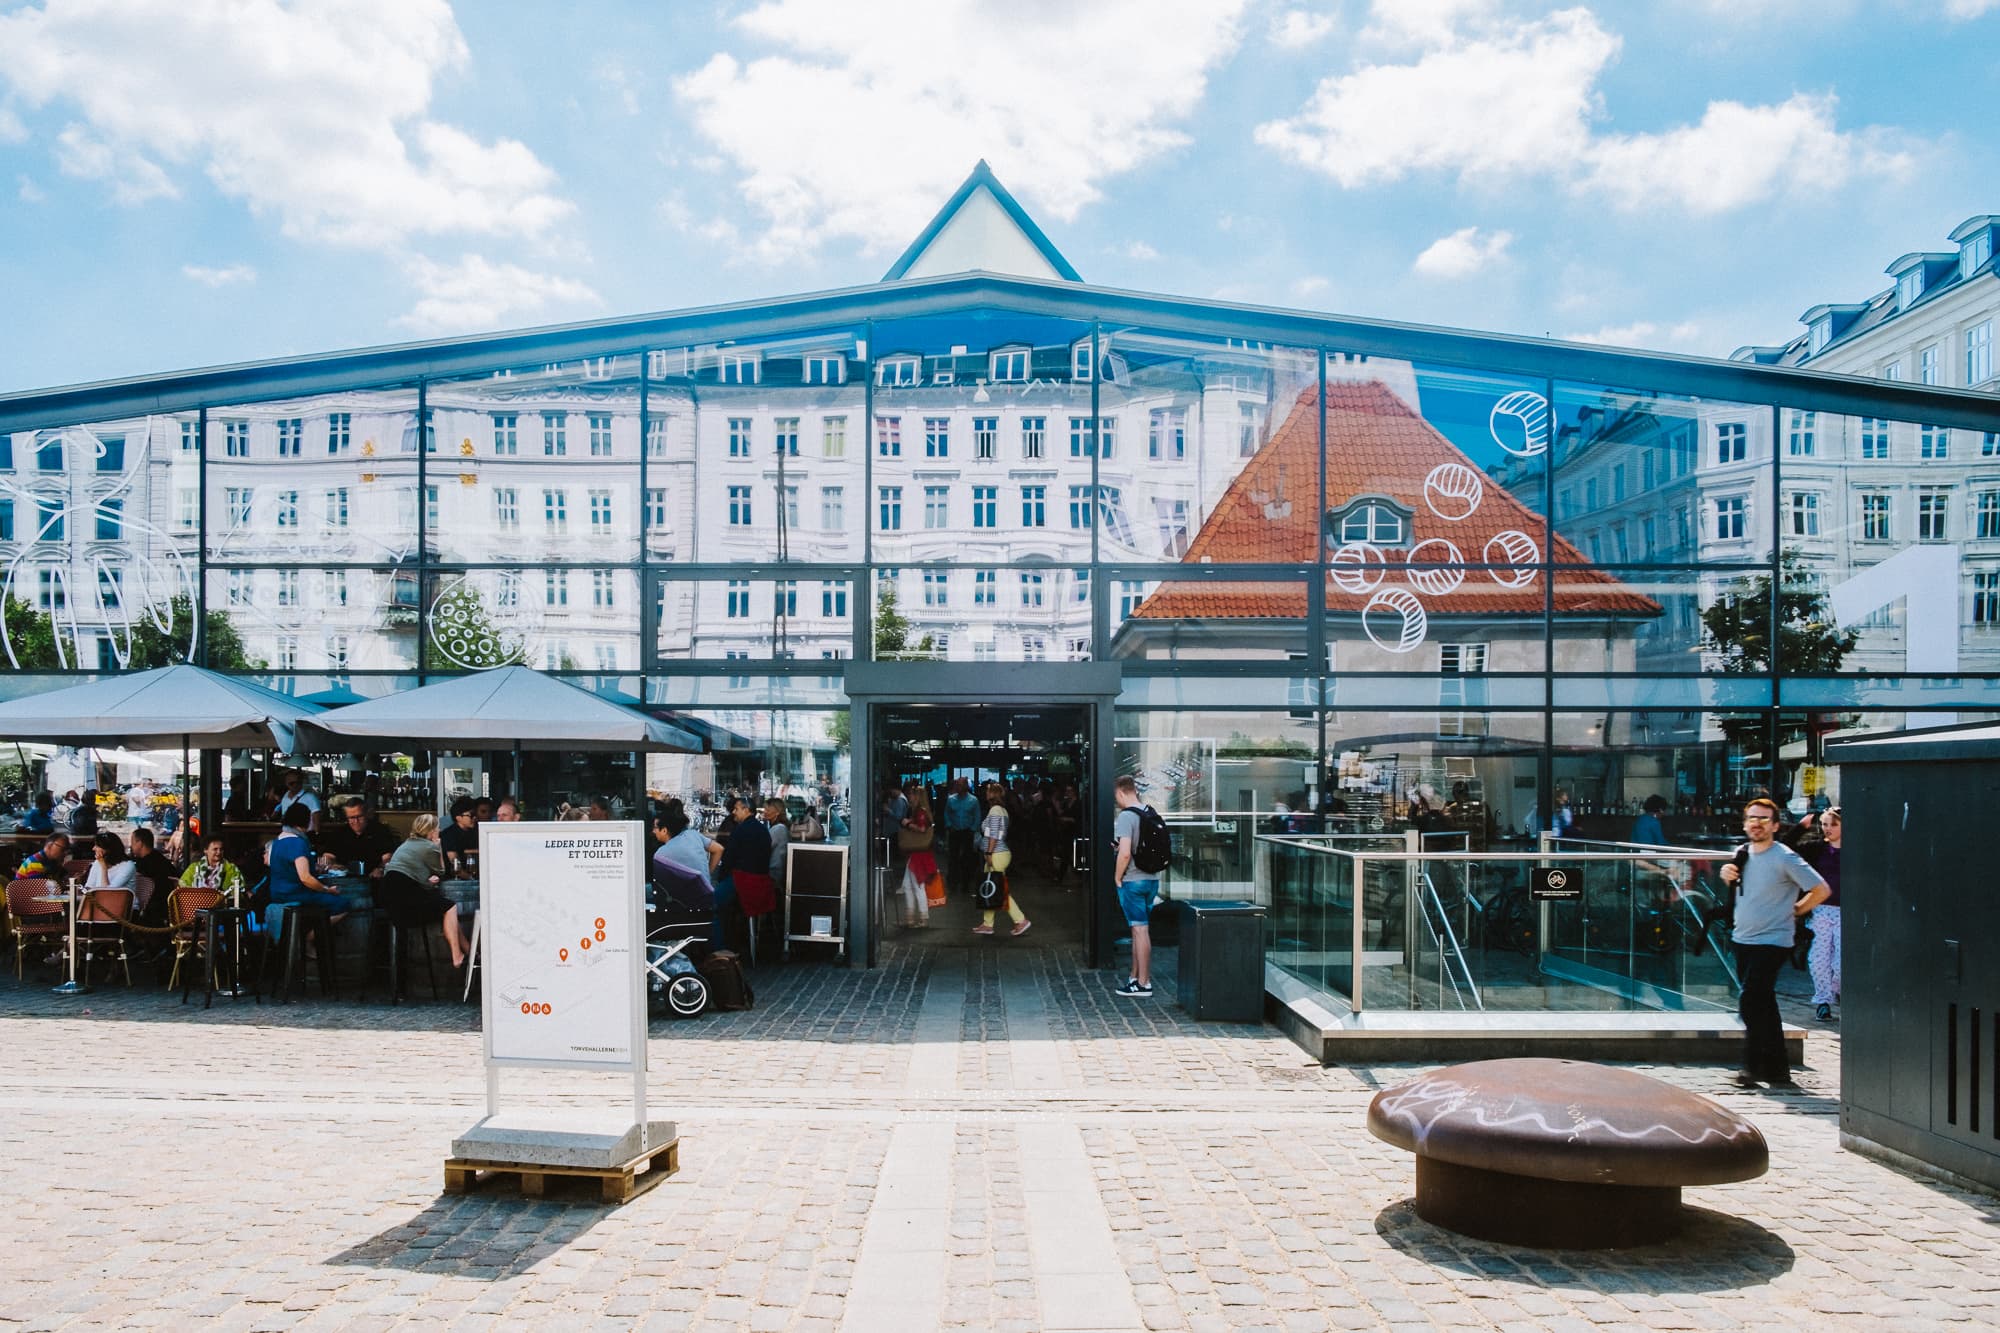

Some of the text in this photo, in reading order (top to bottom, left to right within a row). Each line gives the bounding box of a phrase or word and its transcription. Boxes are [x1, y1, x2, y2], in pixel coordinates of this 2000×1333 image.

[1829, 544, 1958, 729] 1
[545, 840, 575, 848] LEDER
[593, 839, 623, 847] EFTER
[568, 850, 623, 858] ET TOILET?
